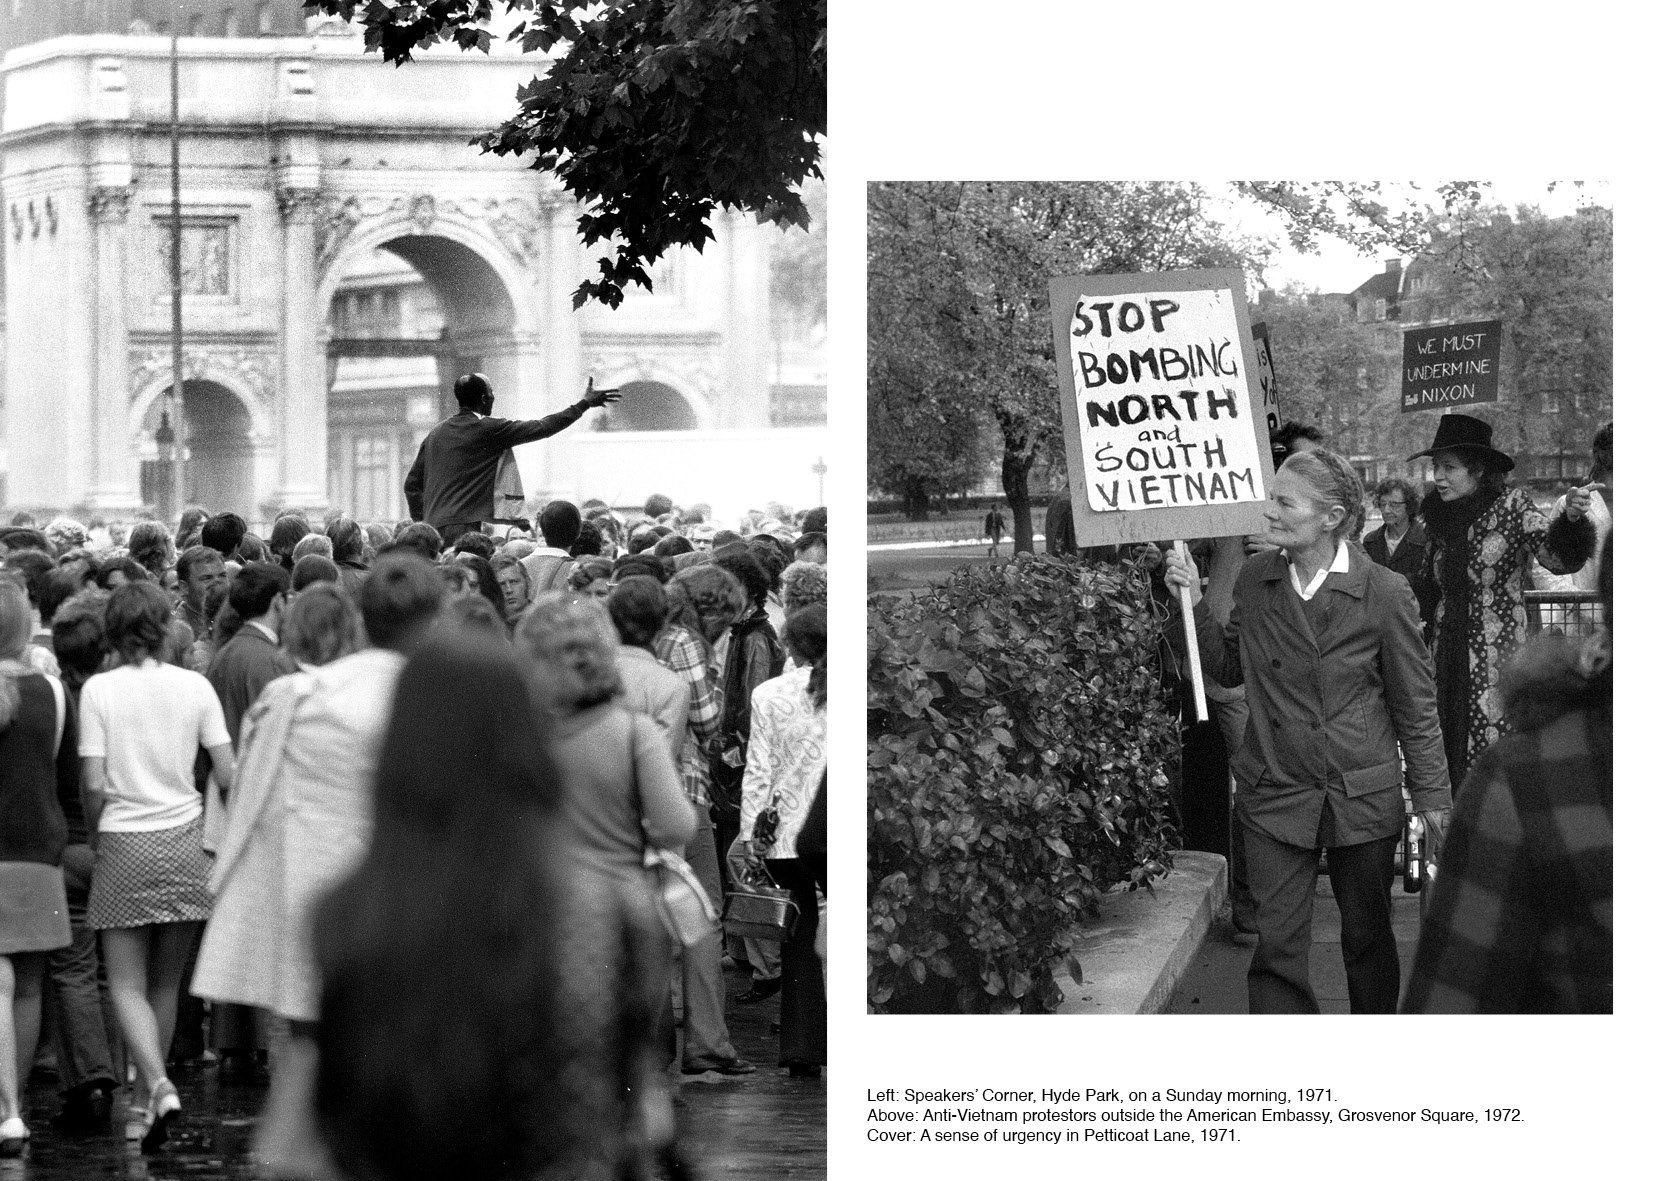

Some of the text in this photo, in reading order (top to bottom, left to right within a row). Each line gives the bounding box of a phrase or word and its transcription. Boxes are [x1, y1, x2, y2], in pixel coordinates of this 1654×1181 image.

[1072, 299, 1180, 337] STOP
[1418, 333, 1487, 355] WE MUST
[1078, 341, 1238, 388] BOMBING
[1408, 359, 1491, 382] UNDERMINE
[1086, 388, 1238, 427] NORTH
[1422, 383, 1475, 403] NIXON
[1138, 425, 1181, 443] and
[1095, 435, 1227, 472] SOUTH
[1096, 468, 1258, 507] VIETNAM
